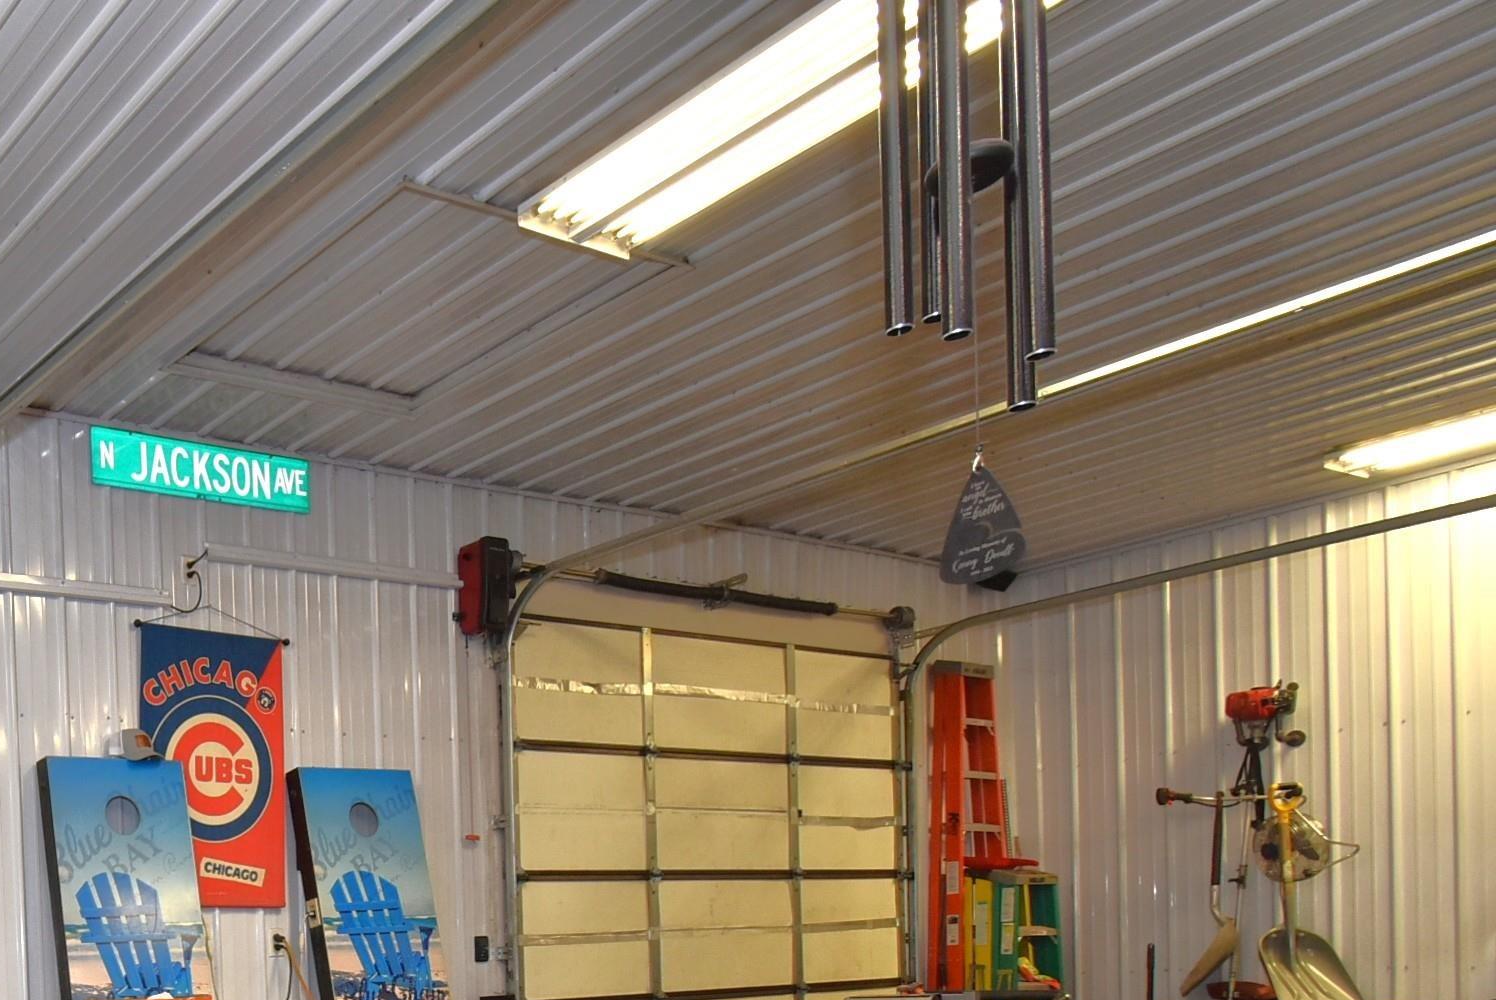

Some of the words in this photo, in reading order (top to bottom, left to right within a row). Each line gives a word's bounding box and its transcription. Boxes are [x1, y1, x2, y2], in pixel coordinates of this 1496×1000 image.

[99, 440, 115, 470] N
[131, 441, 271, 500] JACKSON
[274, 467, 307, 496] AVE
[204, 861, 258, 883] CHICAGO
